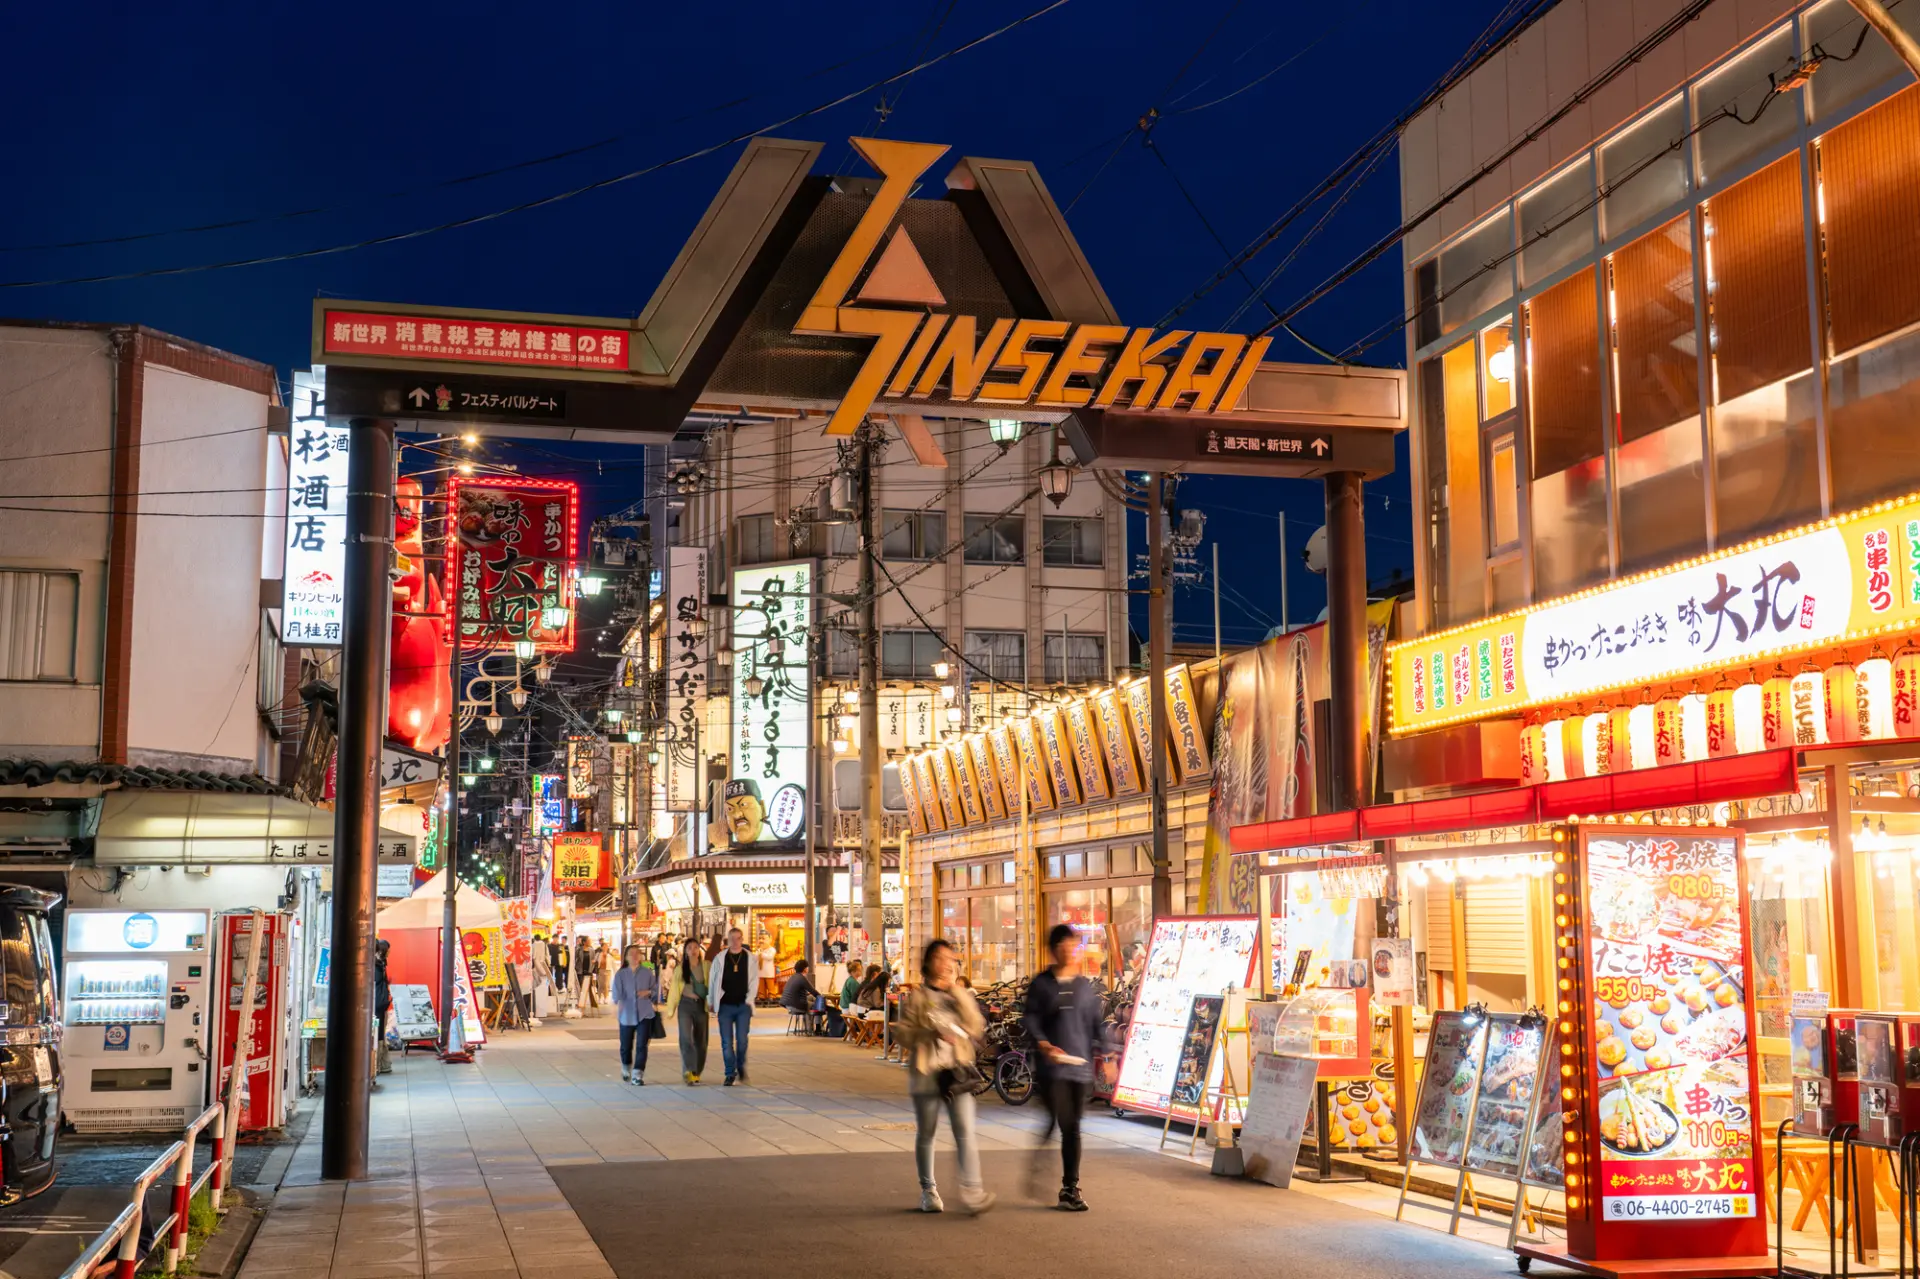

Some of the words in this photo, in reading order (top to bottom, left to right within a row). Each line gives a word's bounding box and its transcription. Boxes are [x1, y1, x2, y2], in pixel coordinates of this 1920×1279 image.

[333, 321, 387, 344] 新世界
[395, 321, 621, 355] 消費税完納推進の街
[460, 392, 558, 412] フェスティバルゲート
[1224, 436, 1303, 453] 通天閣・新世界
[290, 390, 330, 552] 上杉酒店
[543, 502, 562, 552] 串かつ
[288, 591, 342, 604] キリンビール
[461, 550, 482, 635] お好み焼き
[1867, 547, 1892, 612] 串かつ
[286, 621, 341, 639] 月桂冠
[1543, 611, 1668, 678] 串かつ・たこ焼き
[1479, 640, 1491, 700] 焼きそば
[1763, 692, 1777, 744] 味の大丸
[1894, 669, 1911, 725] 味の大丸
[1168, 676, 1202, 771] 千客万来
[1657, 710, 1671, 758] 味の大丸
[1707, 703, 1720, 752] 味の大丸
[270, 843, 329, 858] たばこ
[561, 864, 591, 878] 朝日
[1626, 840, 1734, 873] お好み焼き
[1595, 942, 1694, 977] たこ焼き
[1684, 1082, 1748, 1121] 串かつ
[1626, 1198, 1731, 1217] 06-4400-2745
